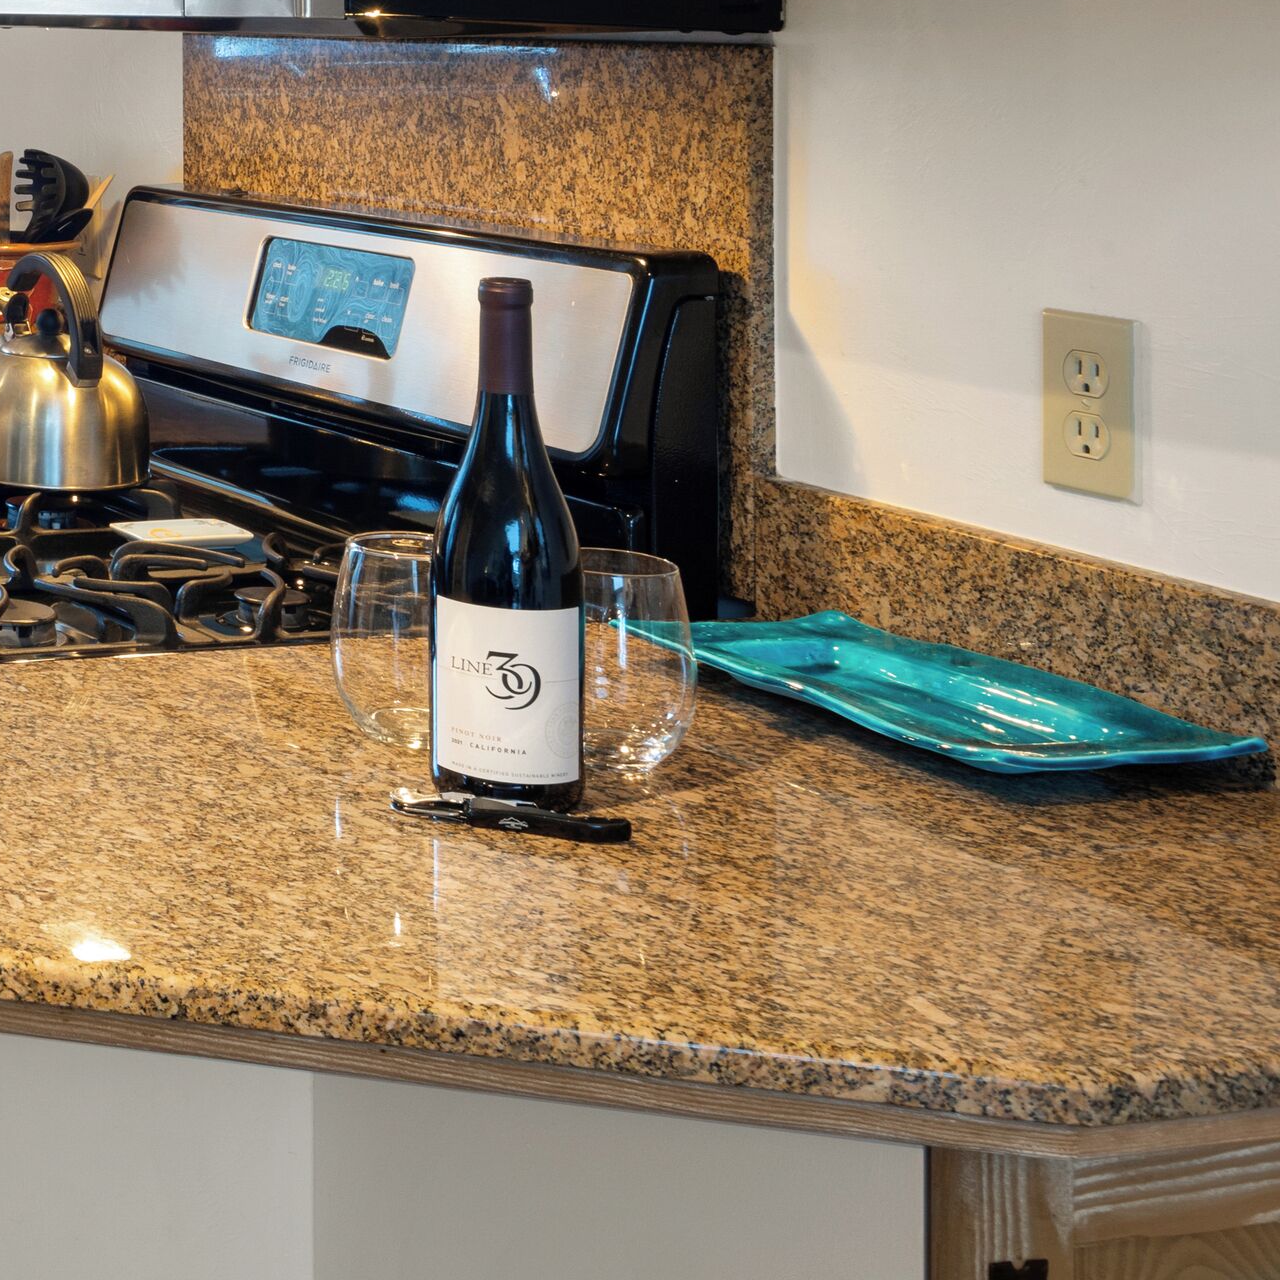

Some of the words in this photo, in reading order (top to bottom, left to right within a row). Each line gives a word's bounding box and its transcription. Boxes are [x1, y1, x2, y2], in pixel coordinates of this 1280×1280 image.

[289, 355, 331, 373] FRIGIDAIRE
[451, 655, 493, 676] LINE
[485, 650, 542, 710] 39
[451, 726, 475, 738] PINOT
[479, 733, 502, 742] NOIR
[469, 742, 527, 755] CALIFORNIA
